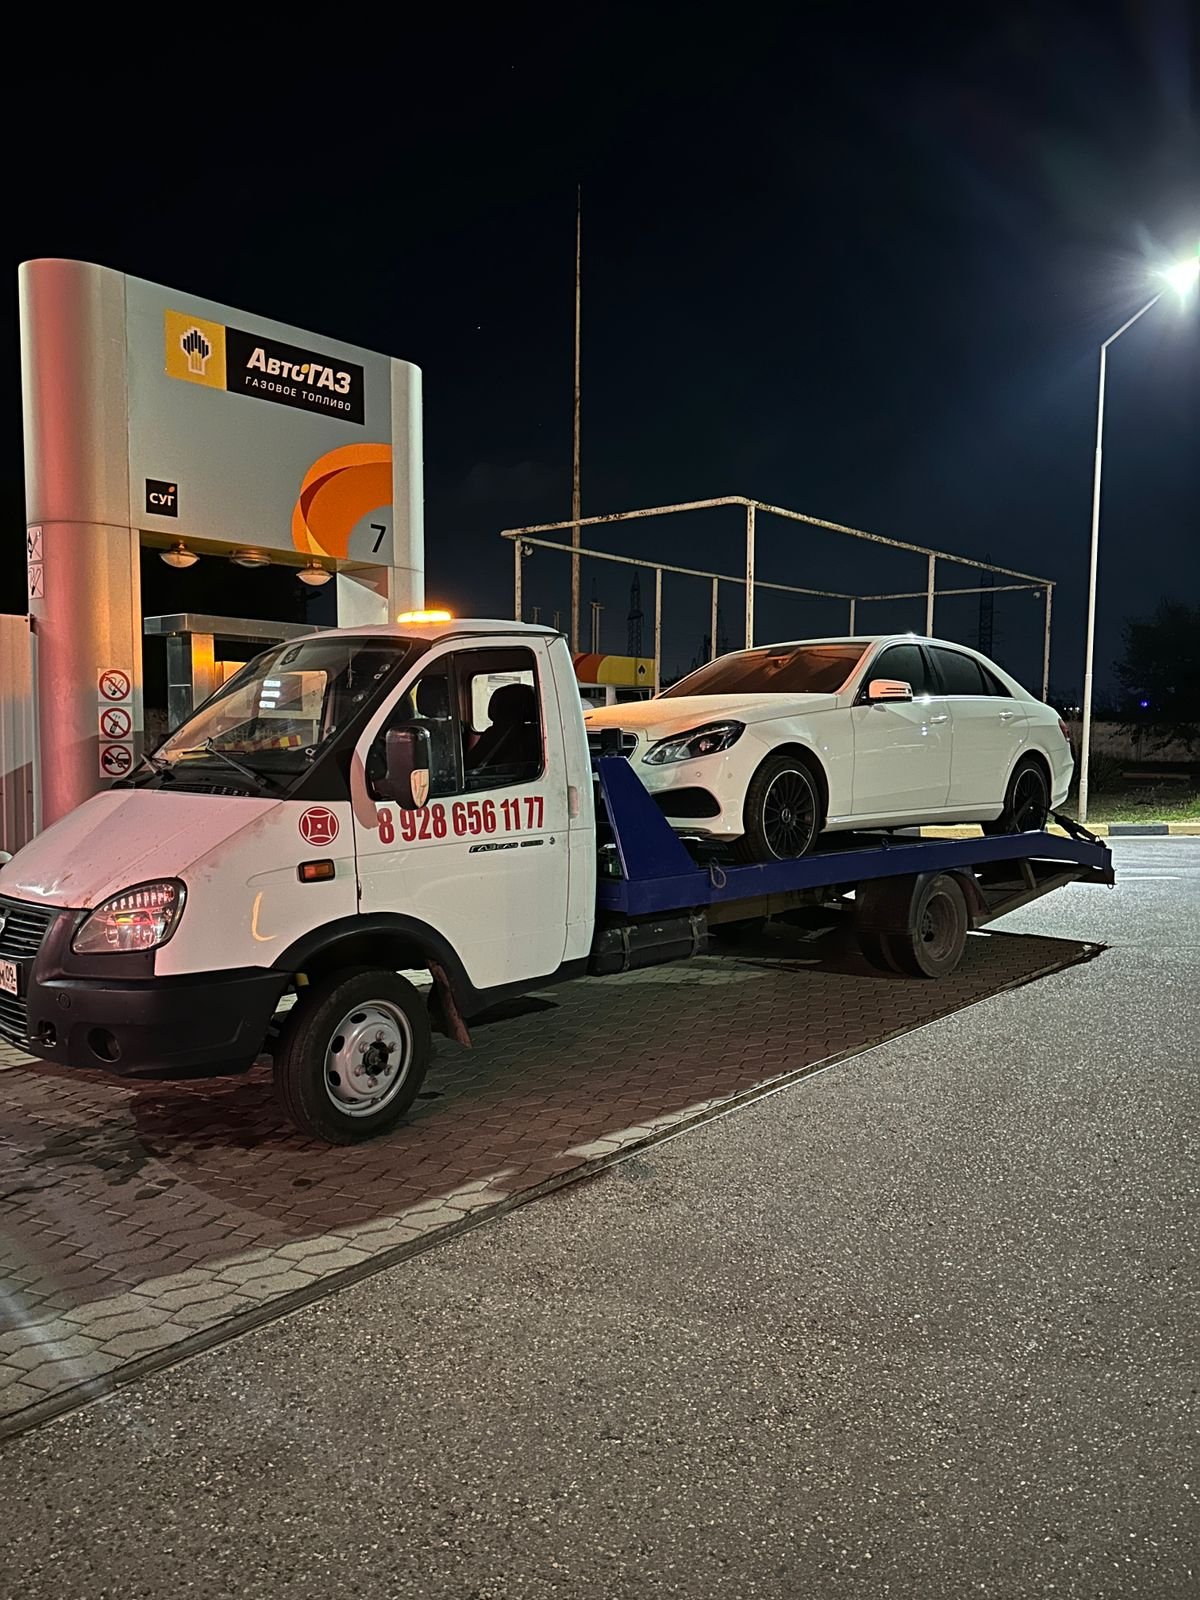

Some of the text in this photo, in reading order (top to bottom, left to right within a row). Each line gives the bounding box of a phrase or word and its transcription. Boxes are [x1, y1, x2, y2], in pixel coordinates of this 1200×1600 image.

[245, 376, 351, 411] ГАЗОВОЕ ТОПЛИВО
[149, 492, 175, 506] СУГ
[370, 523, 387, 553] 7
[377, 808, 395, 844] 8
[400, 803, 447, 842] 928
[452, 799, 496, 836] 656
